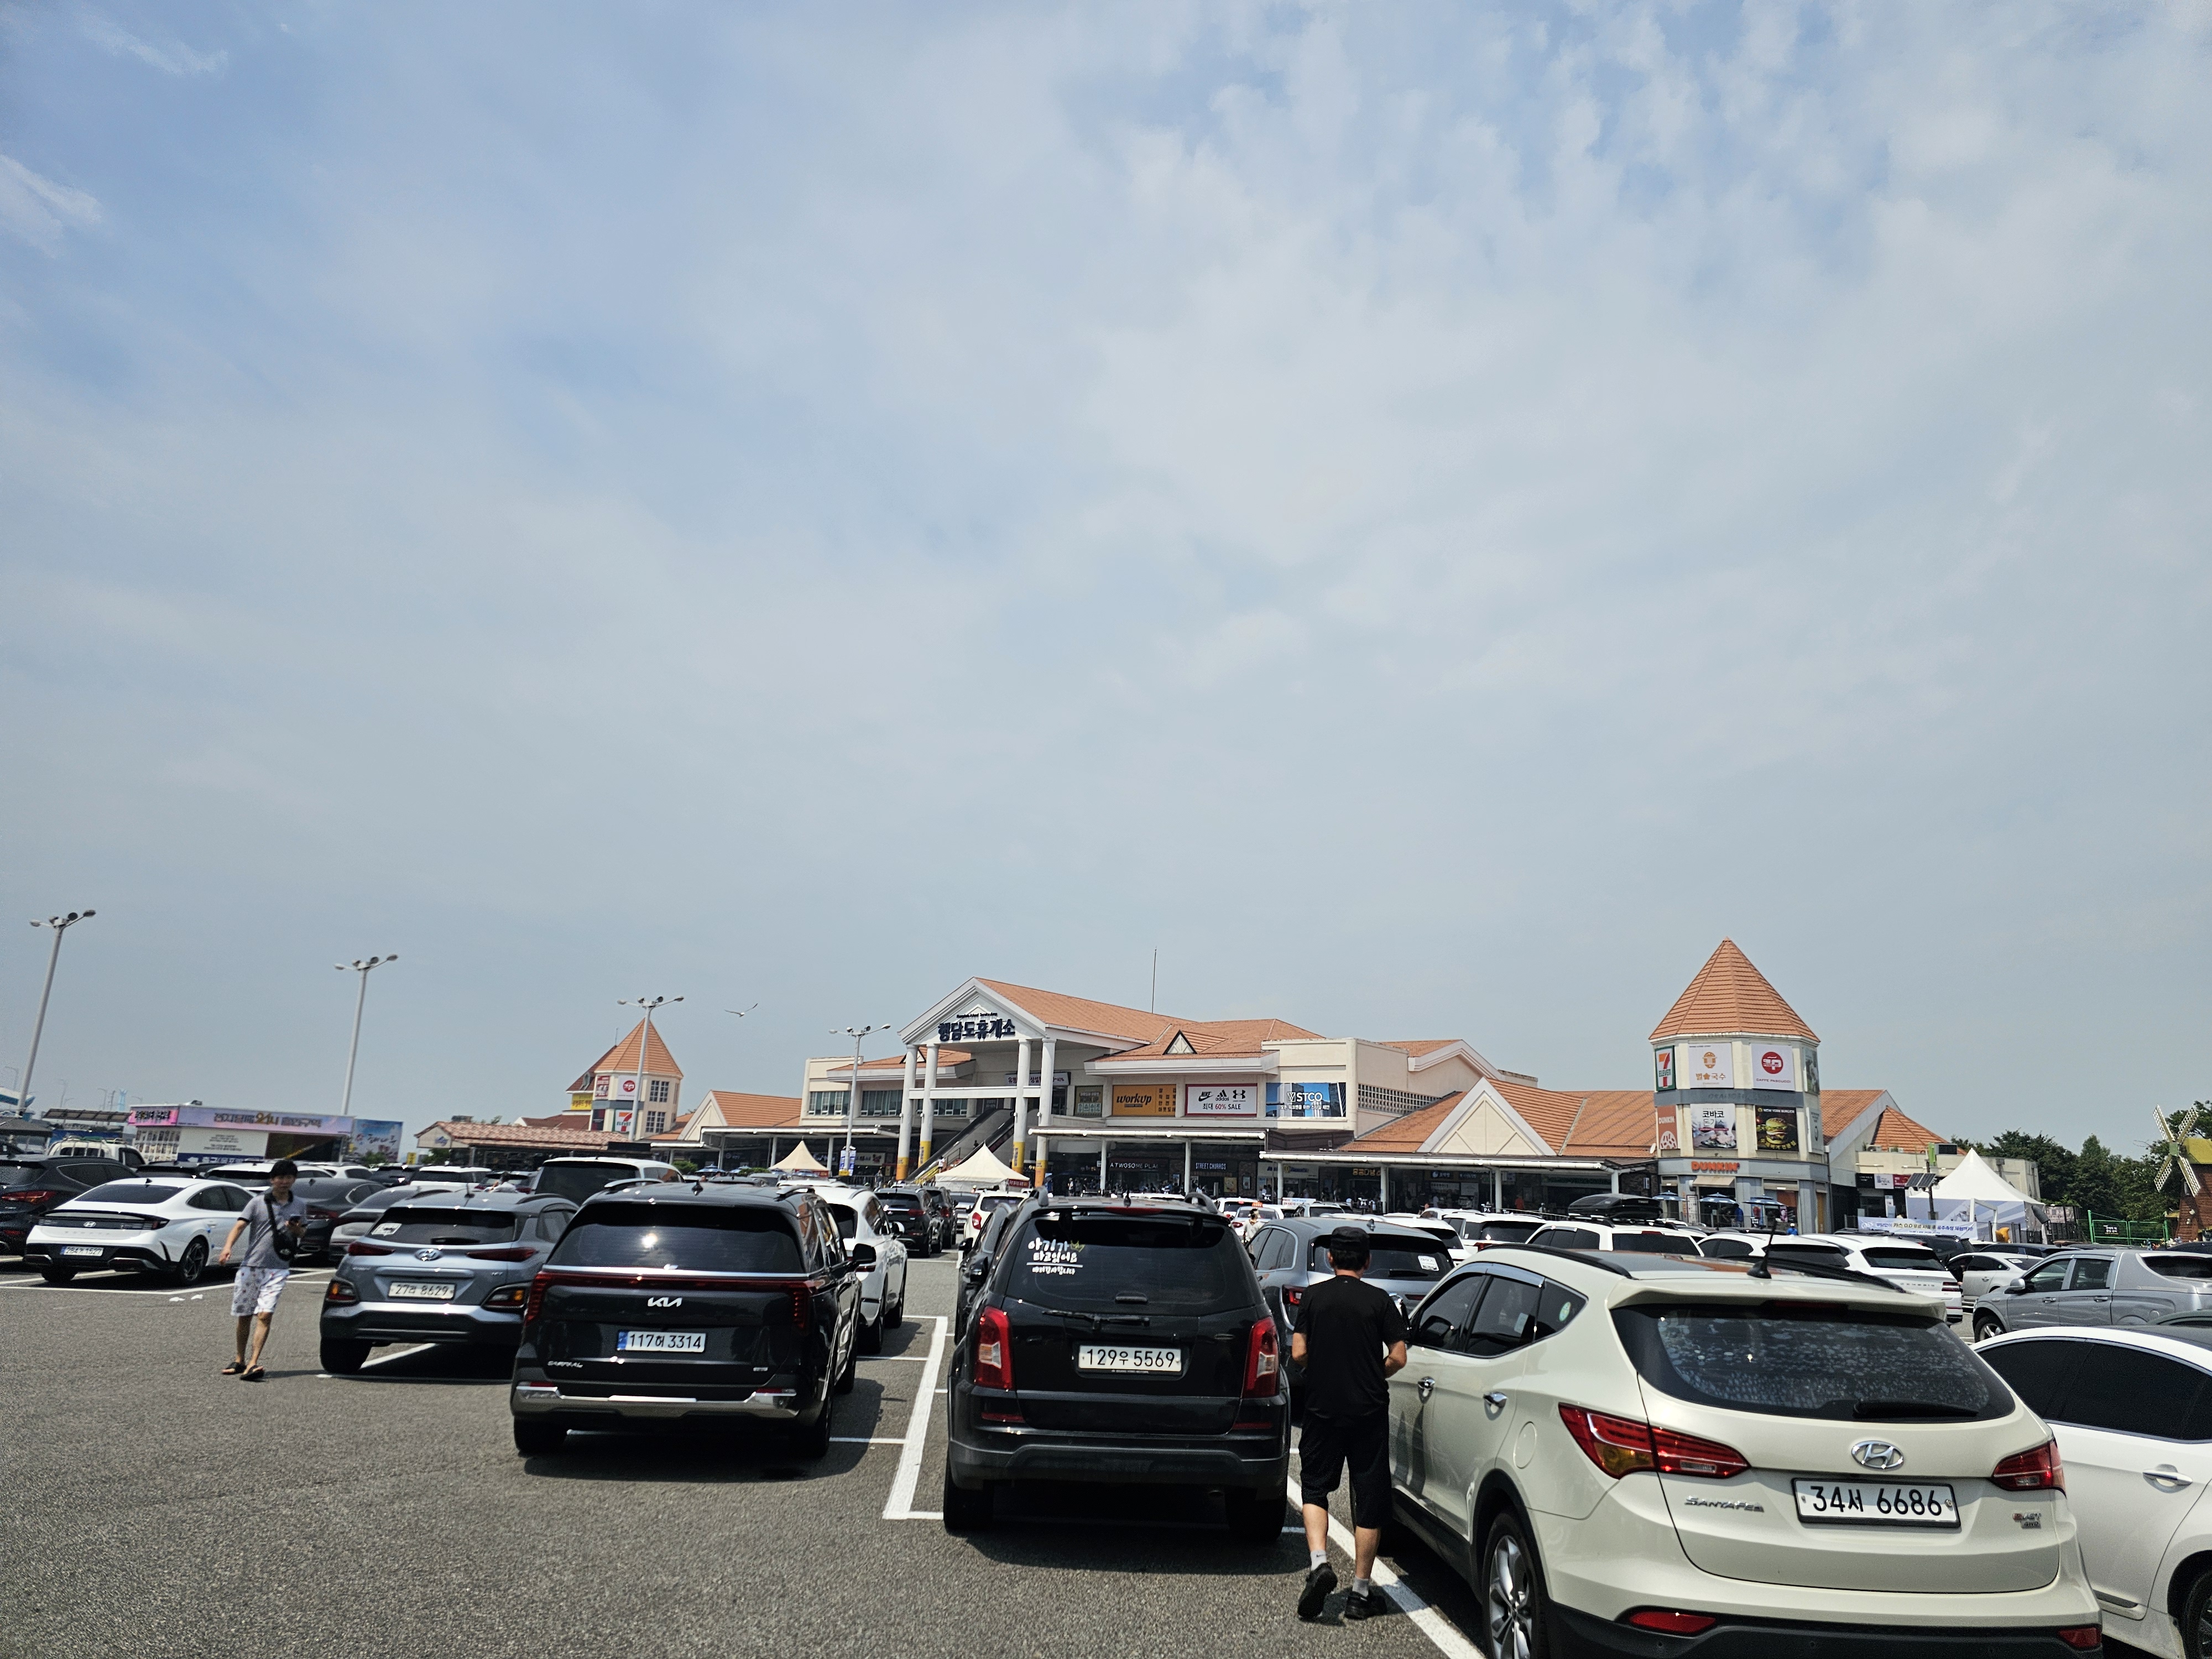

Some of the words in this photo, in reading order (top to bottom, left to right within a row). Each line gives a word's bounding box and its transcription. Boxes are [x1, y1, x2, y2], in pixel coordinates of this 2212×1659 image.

[938, 1019, 1015, 1041] 행담도휴게소
[420, 1285, 450, 1296] 8629
[667, 1335, 702, 1349] 3314
[1087, 1349, 1128, 1365] 129우
[1134, 1350, 1175, 1368] 5569
[1810, 1485, 1864, 1512] 34서
[1876, 1488, 1942, 1516] 6686
